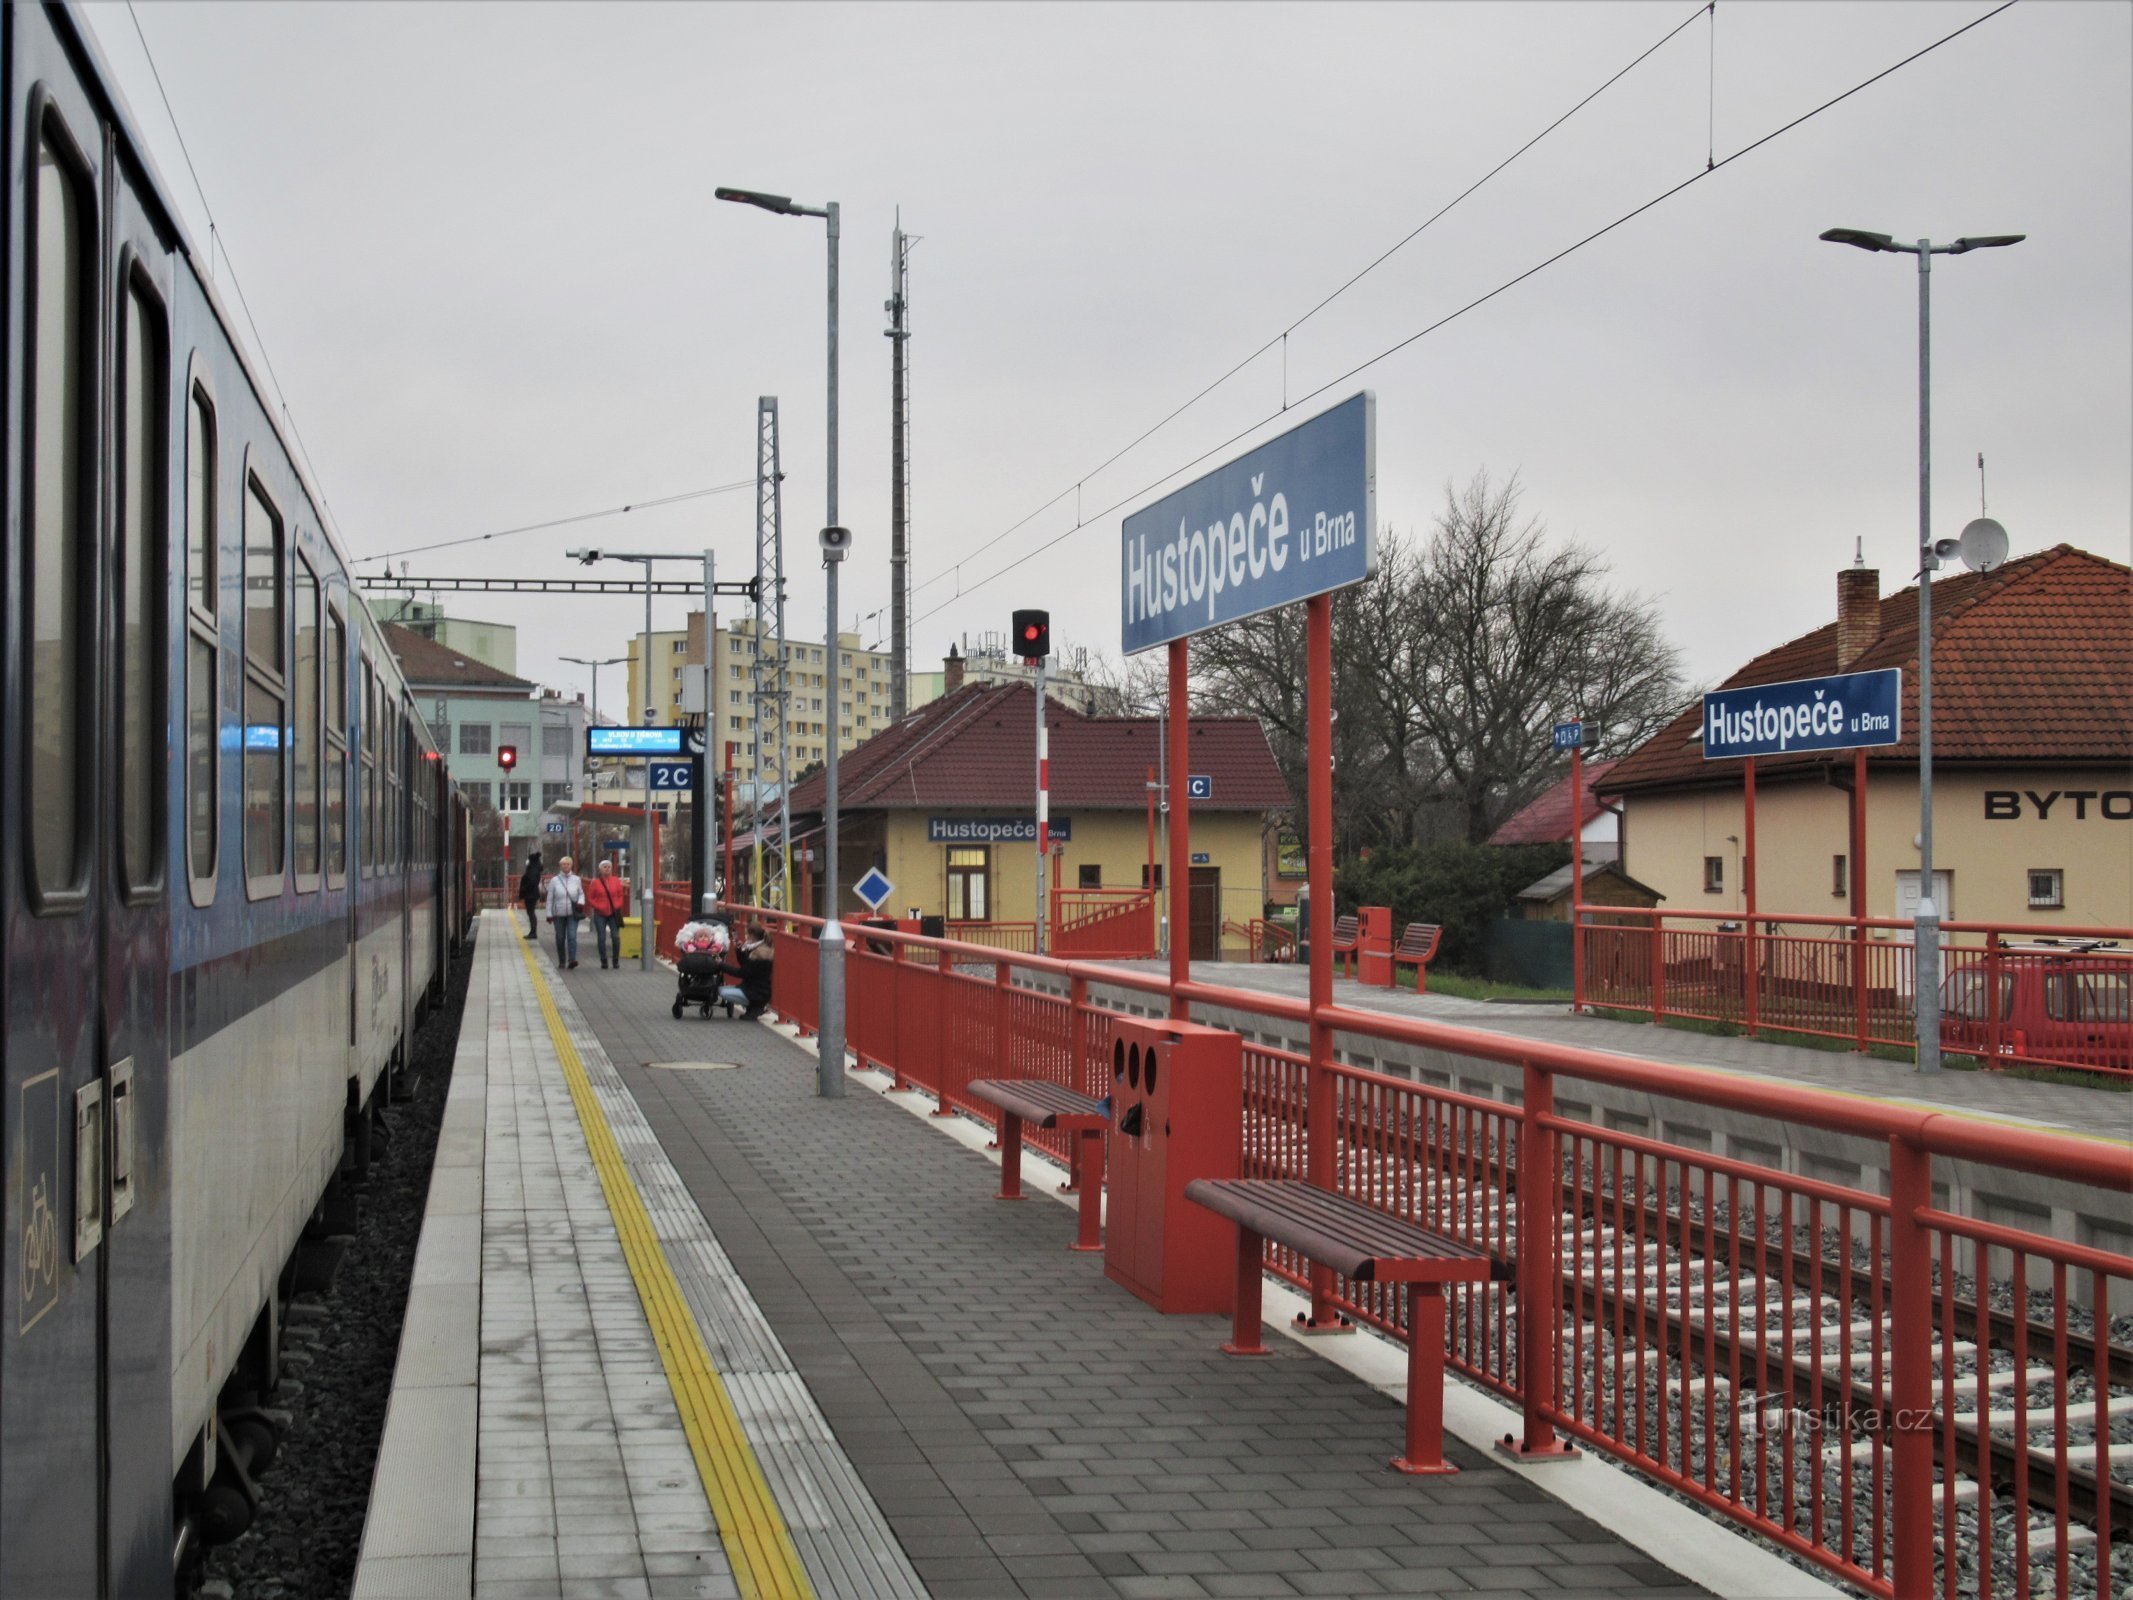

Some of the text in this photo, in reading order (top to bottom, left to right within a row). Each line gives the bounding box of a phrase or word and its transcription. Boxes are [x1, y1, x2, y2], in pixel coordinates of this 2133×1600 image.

[1128, 471, 1355, 625] Hustopeče u Brna
[1709, 689, 1889, 750] Hustopeče u Brna
[1984, 790, 2133, 820] BYTO
[932, 820, 1067, 841] Hustopeče Brna
